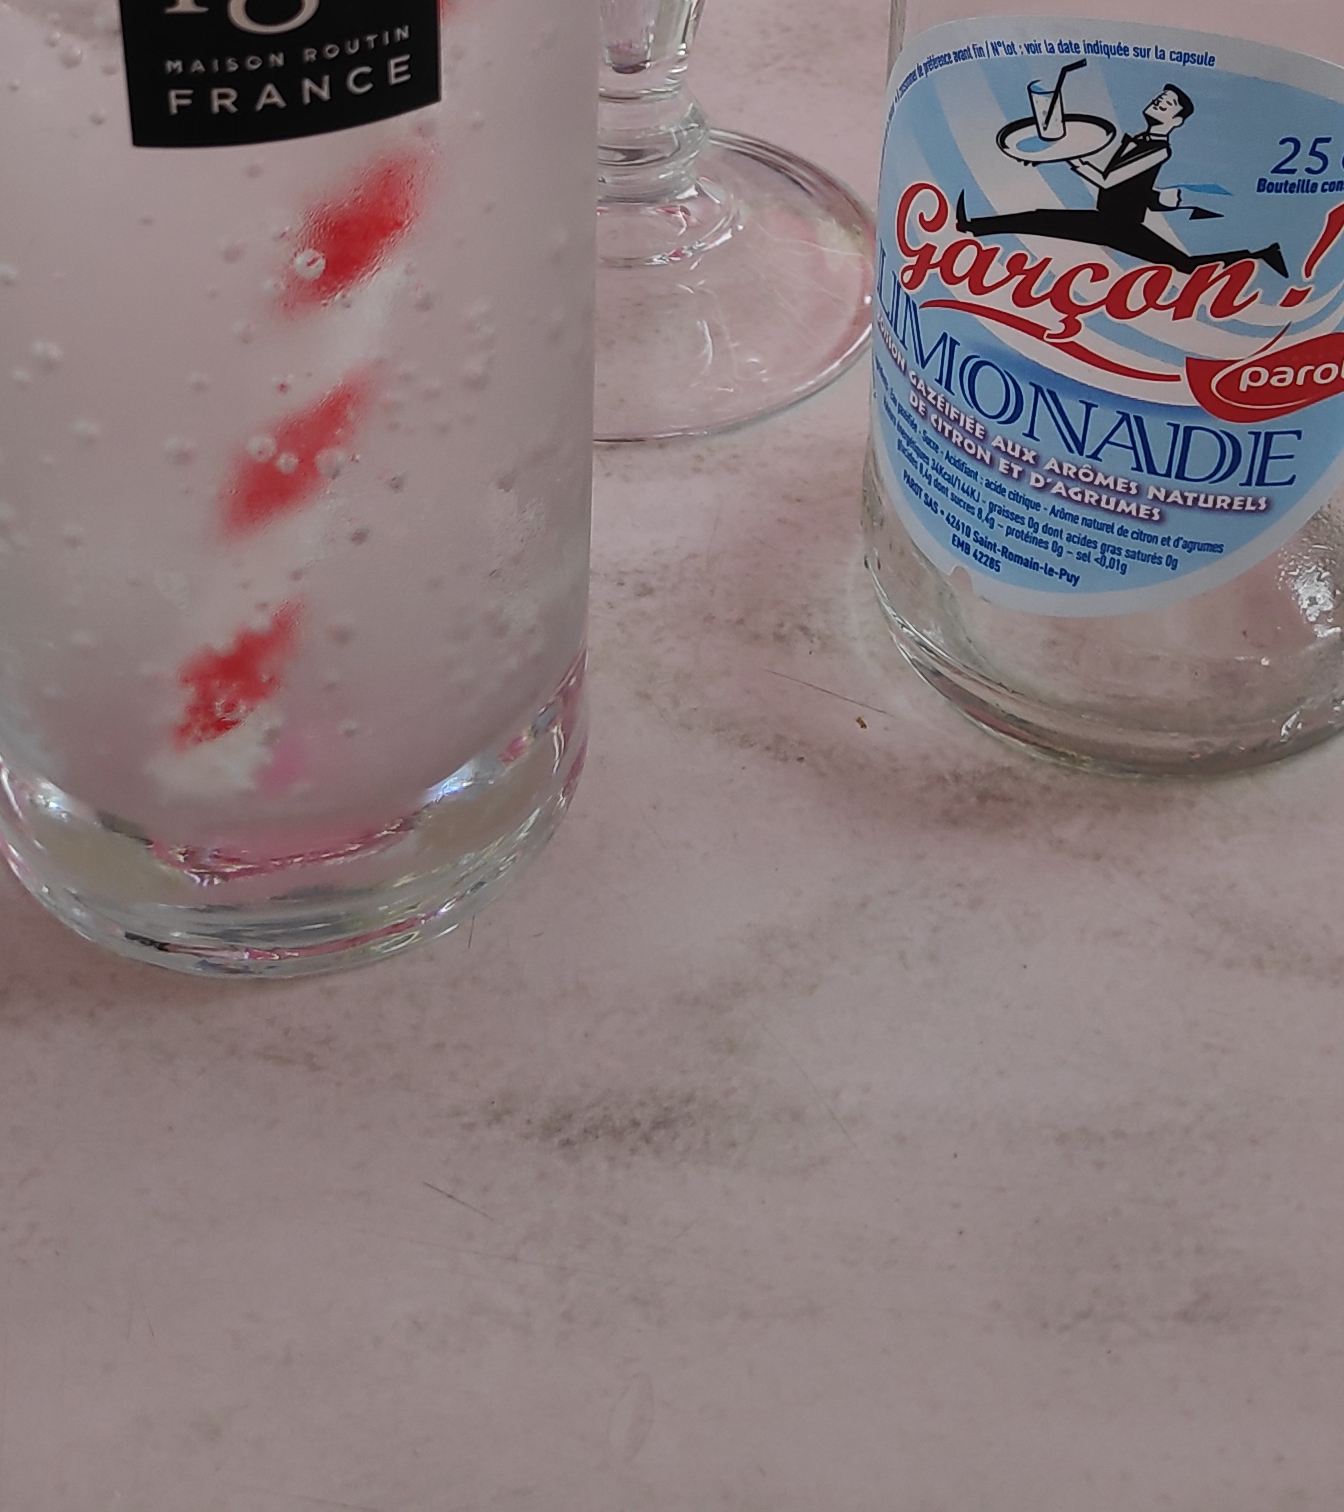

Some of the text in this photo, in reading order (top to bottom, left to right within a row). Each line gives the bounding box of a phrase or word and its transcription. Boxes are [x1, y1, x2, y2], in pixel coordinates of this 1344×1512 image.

[164, 25, 412, 74] MAISON ROUTIN
[1044, 39, 1055, 54] la
[1057, 39, 1081, 55] date
[1082, 39, 1130, 59] indiquée
[1132, 46, 1151, 59] sur
[1155, 45, 1166, 60] la
[1169, 50, 1216, 67] capsule
[167, 54, 412, 116] FRANCE
[1256, 178, 1318, 194] Bouteille
[1270, 136, 1332, 175] 25
[877, 239, 1302, 486] LIMONADE
[908, 369, 986, 439] GAZÉIFIÉE
[991, 435, 1037, 465] AUX
[1043, 457, 1139, 495] ARÔMES
[1147, 485, 1268, 511] NATURELS
[909, 392, 1161, 521] DE CITRON ET D'AGRUMES
[923, 495, 939, 515] SAS
[945, 512, 972, 539] 42610
[972, 530, 1081, 587] Saint-Romain-le-Puy
[984, 478, 1007, 497] acide
[1007, 490, 1042, 512] citrique
[1049, 504, 1080, 523] Arôme
[1080, 517, 1115, 535] naturel
[1116, 525, 1129, 538] de
[1130, 528, 1159, 544] citron
[1160, 536, 1171, 547] et
[1172, 538, 1225, 554] d'agrumes
[988, 501, 1025, 526] graisses
[1027, 516, 1040, 534] 0g
[1041, 522, 1064, 540] dont
[1065, 532, 1098, 550] acides
[1099, 542, 1123, 555] gras
[1124, 547, 1163, 565] saturés
[1164, 556, 1179, 571] 0g
[1005, 524, 1049, 550] protéines
[1051, 540, 1064, 558] 0g
[1075, 549, 1091, 564] sel
[951, 533, 1002, 573] EMB 42285
